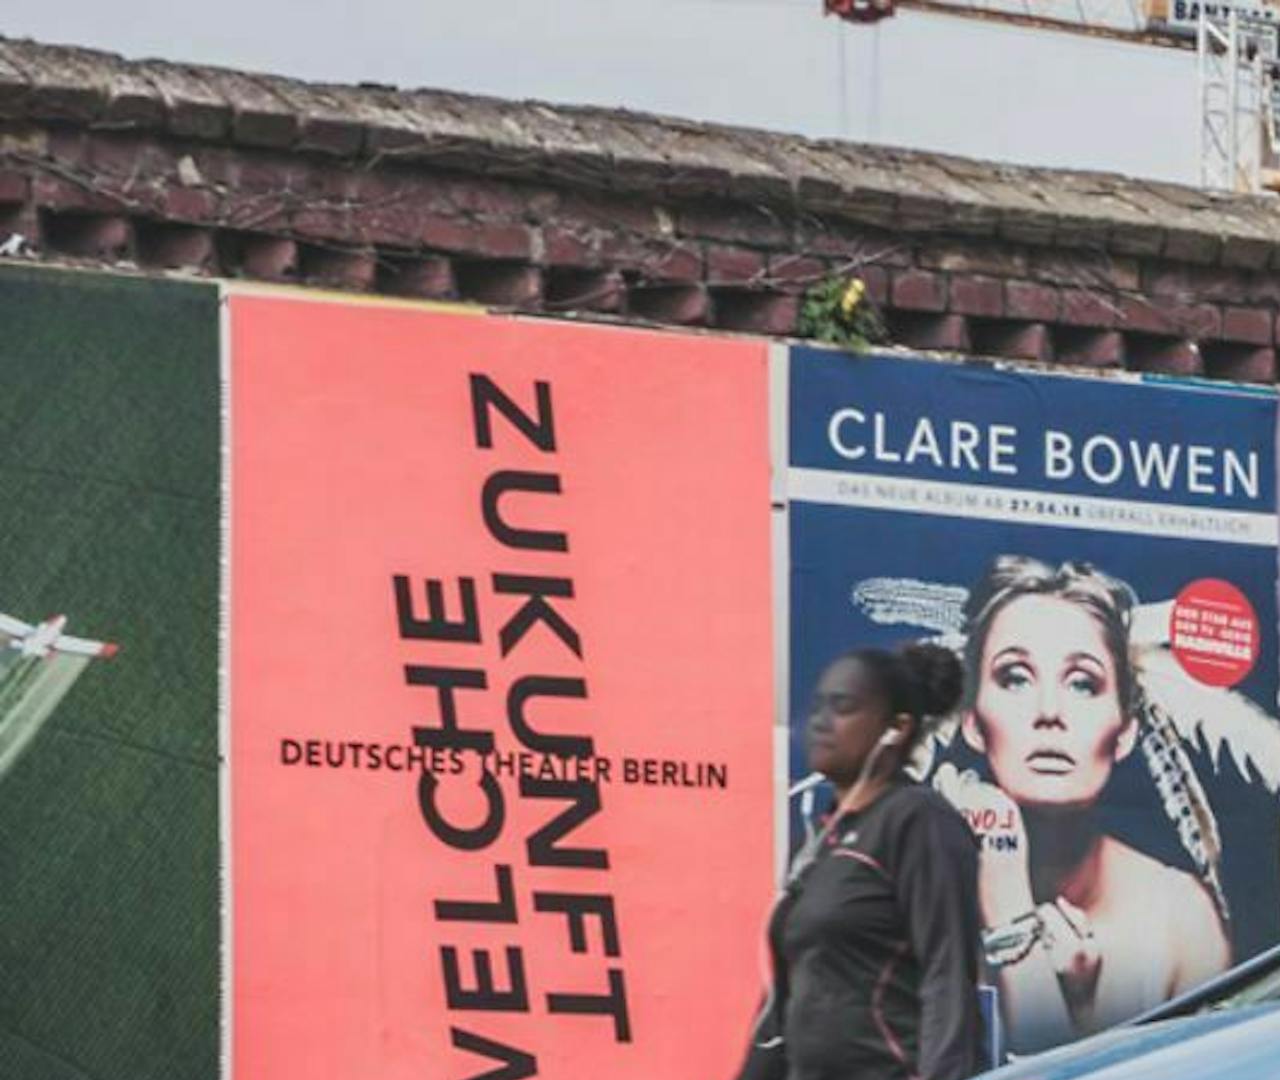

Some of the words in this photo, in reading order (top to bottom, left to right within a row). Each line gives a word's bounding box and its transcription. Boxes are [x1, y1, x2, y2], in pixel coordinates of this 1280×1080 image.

[828, 408, 1018, 475] CLARE
[1045, 430, 1258, 499] BOWEN
[623, 760, 729, 790] BERLIN
